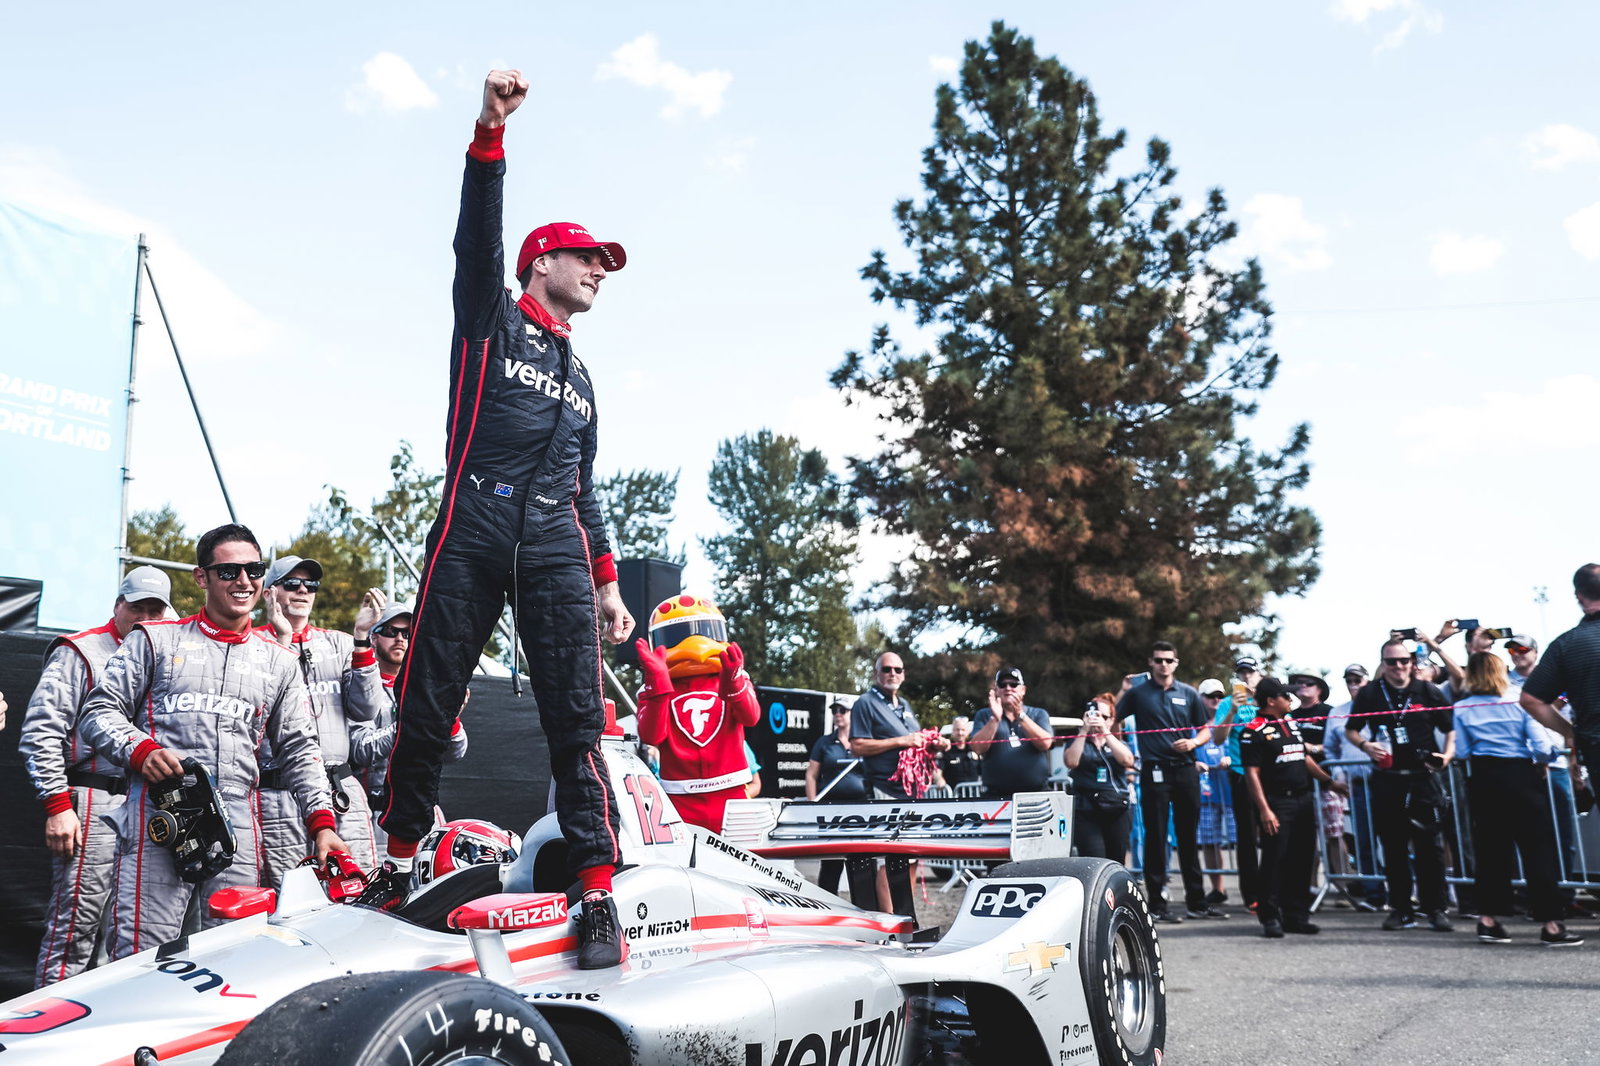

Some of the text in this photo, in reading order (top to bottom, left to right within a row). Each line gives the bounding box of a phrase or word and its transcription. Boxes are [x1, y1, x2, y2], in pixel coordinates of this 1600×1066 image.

[58, 388, 113, 418] PRIX
[504, 357, 592, 423] verizon
[535, 494, 559, 506] POWER
[163, 688, 255, 724] verizon
[786, 709, 810, 729] NTT
[689, 779, 732, 789] FIREHAWK
[623, 773, 674, 845] 12
[816, 808, 985, 833] verizon
[706, 835, 803, 893] PENSKE Truck Rental
[487, 900, 567, 929] Mazak
[974, 886, 1044, 915] PPG
[1059, 1044, 1093, 1062] Firestone
